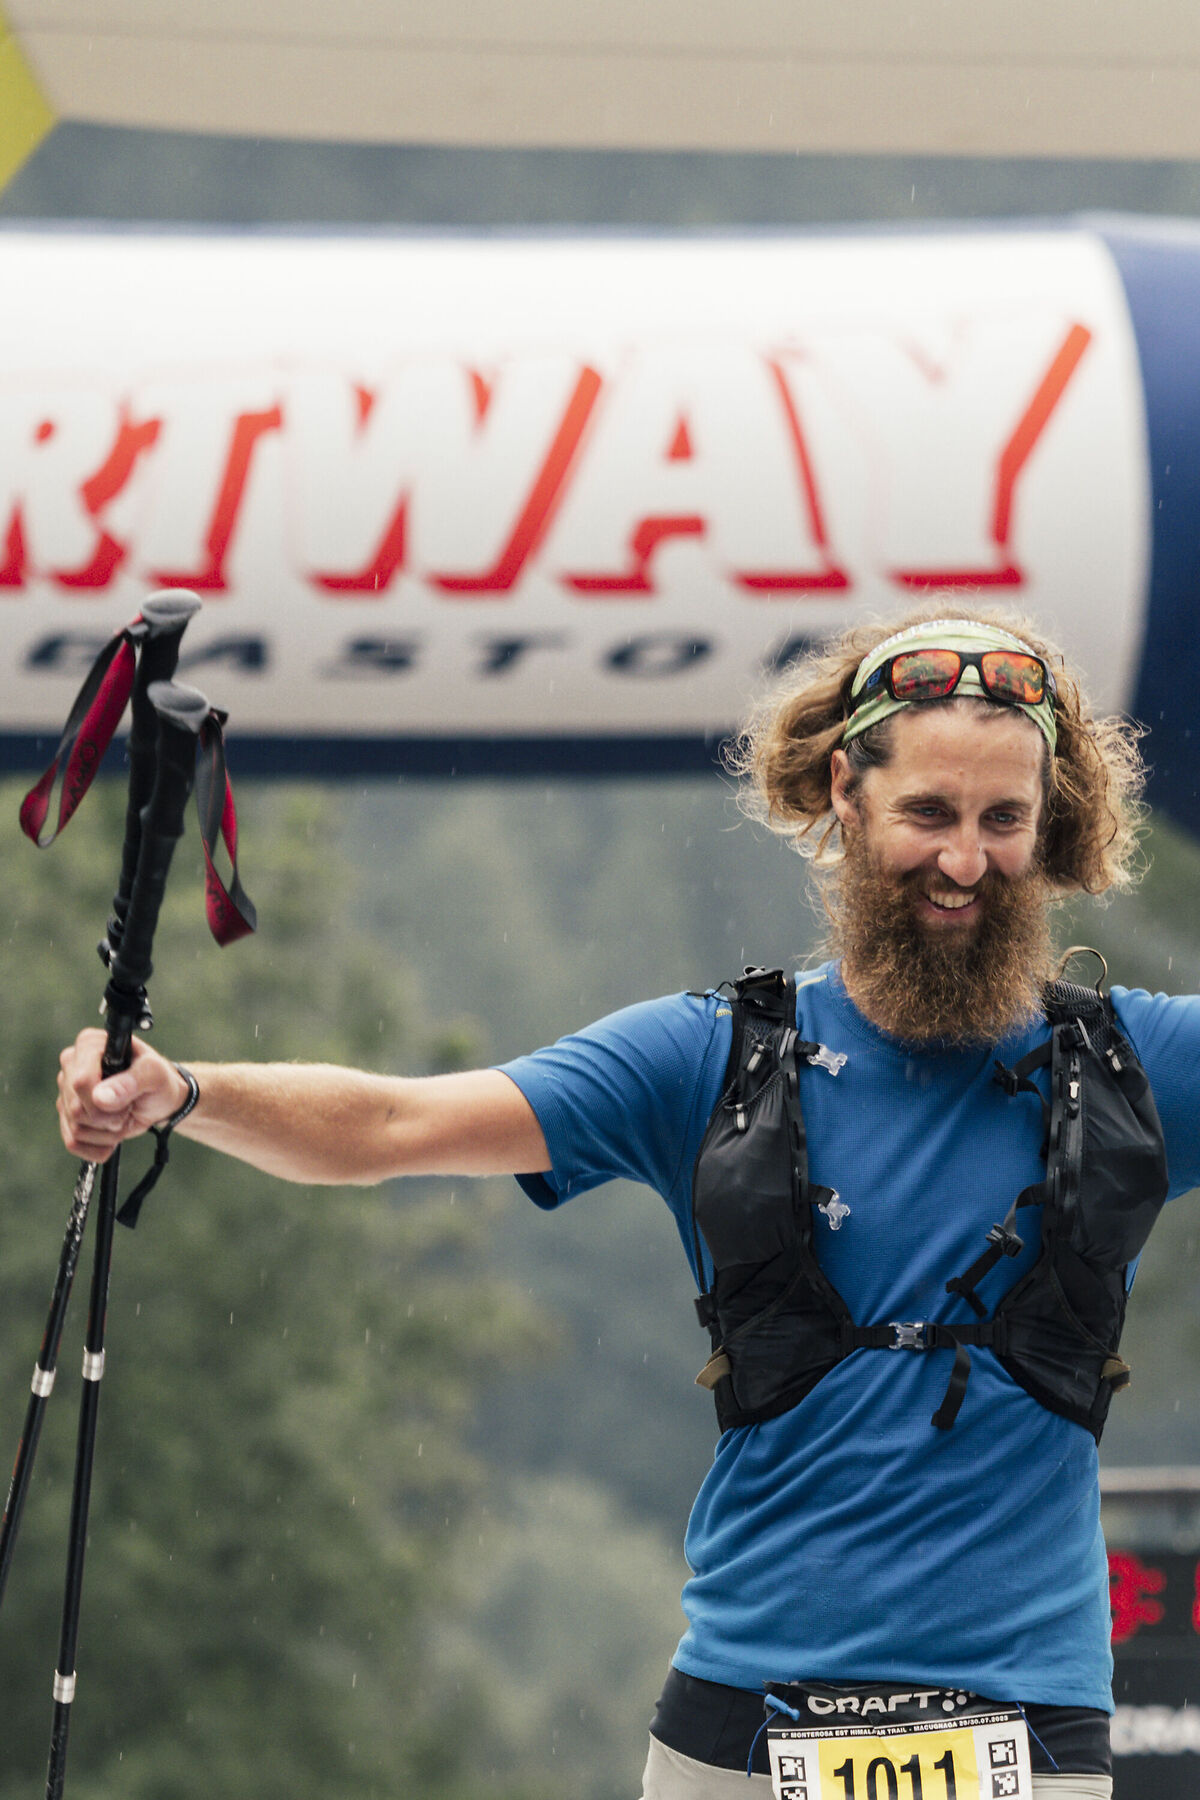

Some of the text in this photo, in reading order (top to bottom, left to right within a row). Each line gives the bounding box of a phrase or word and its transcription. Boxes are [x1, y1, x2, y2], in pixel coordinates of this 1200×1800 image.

[807, 1691, 940, 1717] CRAFT
[790, 1730, 834, 1739] MONTEROSA
[835, 1729, 848, 1737] EST
[887, 1726, 907, 1735] TRAIL
[833, 1750, 958, 1800] 1011
